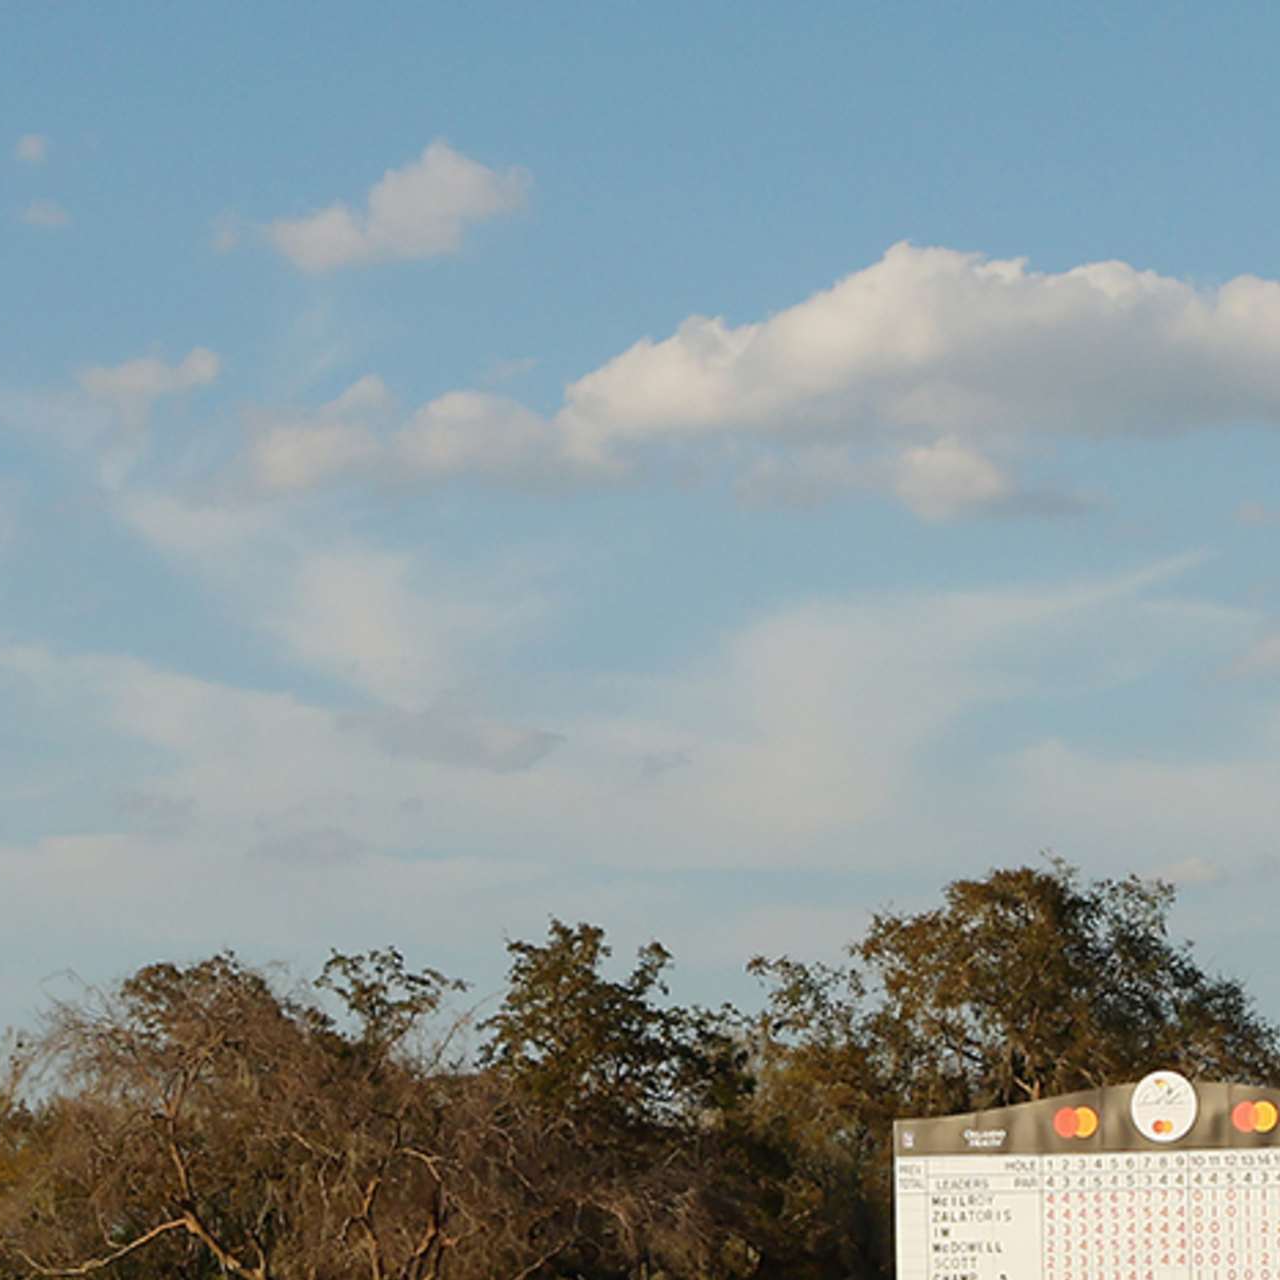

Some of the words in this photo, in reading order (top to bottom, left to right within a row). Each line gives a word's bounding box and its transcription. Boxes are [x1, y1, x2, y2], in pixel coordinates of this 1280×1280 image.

[1006, 1161, 1036, 1172] HOLE
[936, 1179, 989, 1190] LEADERS
[932, 1194, 993, 1207] McILROY
[932, 1210, 1012, 1223] ZALATORIS
[932, 1242, 1002, 1253] McDOWELL
[934, 1257, 977, 1269] SCOTT
